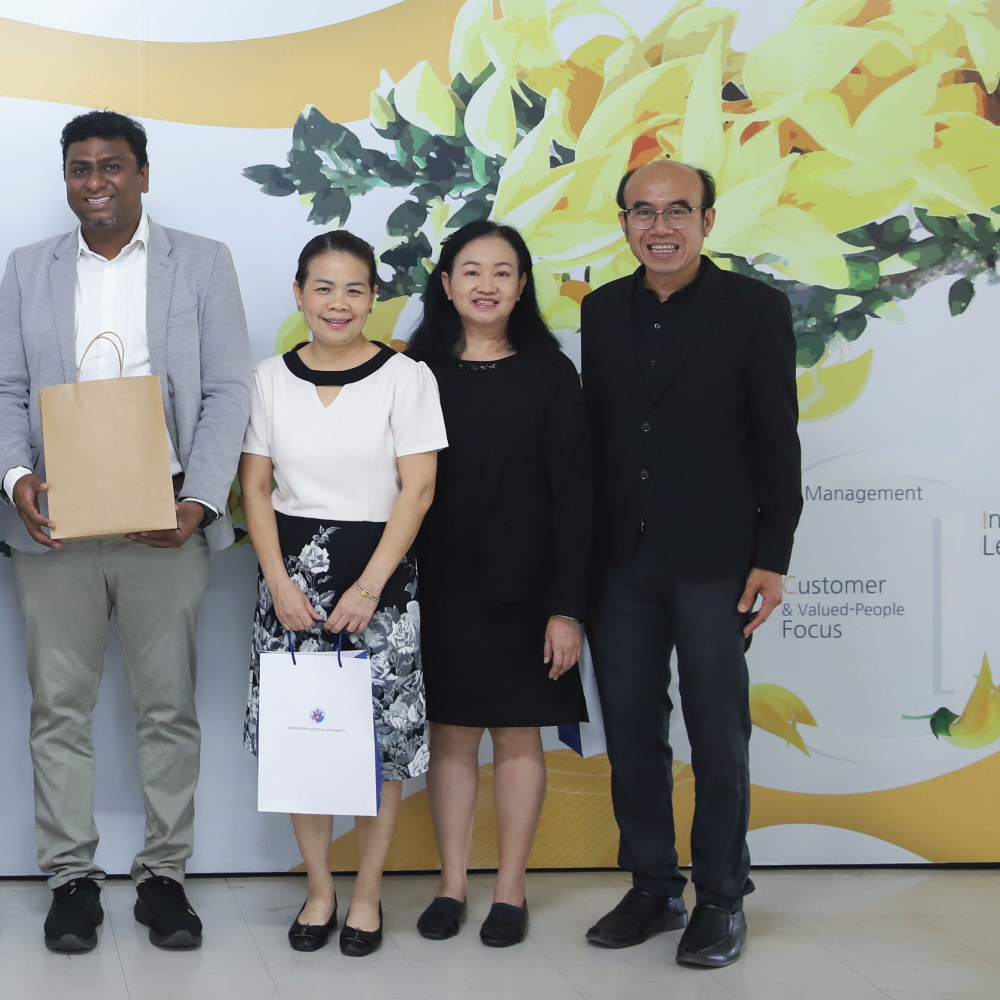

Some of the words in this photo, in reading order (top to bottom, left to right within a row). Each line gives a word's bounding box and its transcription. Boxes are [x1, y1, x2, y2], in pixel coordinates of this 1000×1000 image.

[805, 485, 924, 504] Management
[783, 575, 887, 595] Customer
[781, 603, 793, 617] &
[799, 602, 905, 618] Valued-People
[782, 620, 843, 639] Focus
